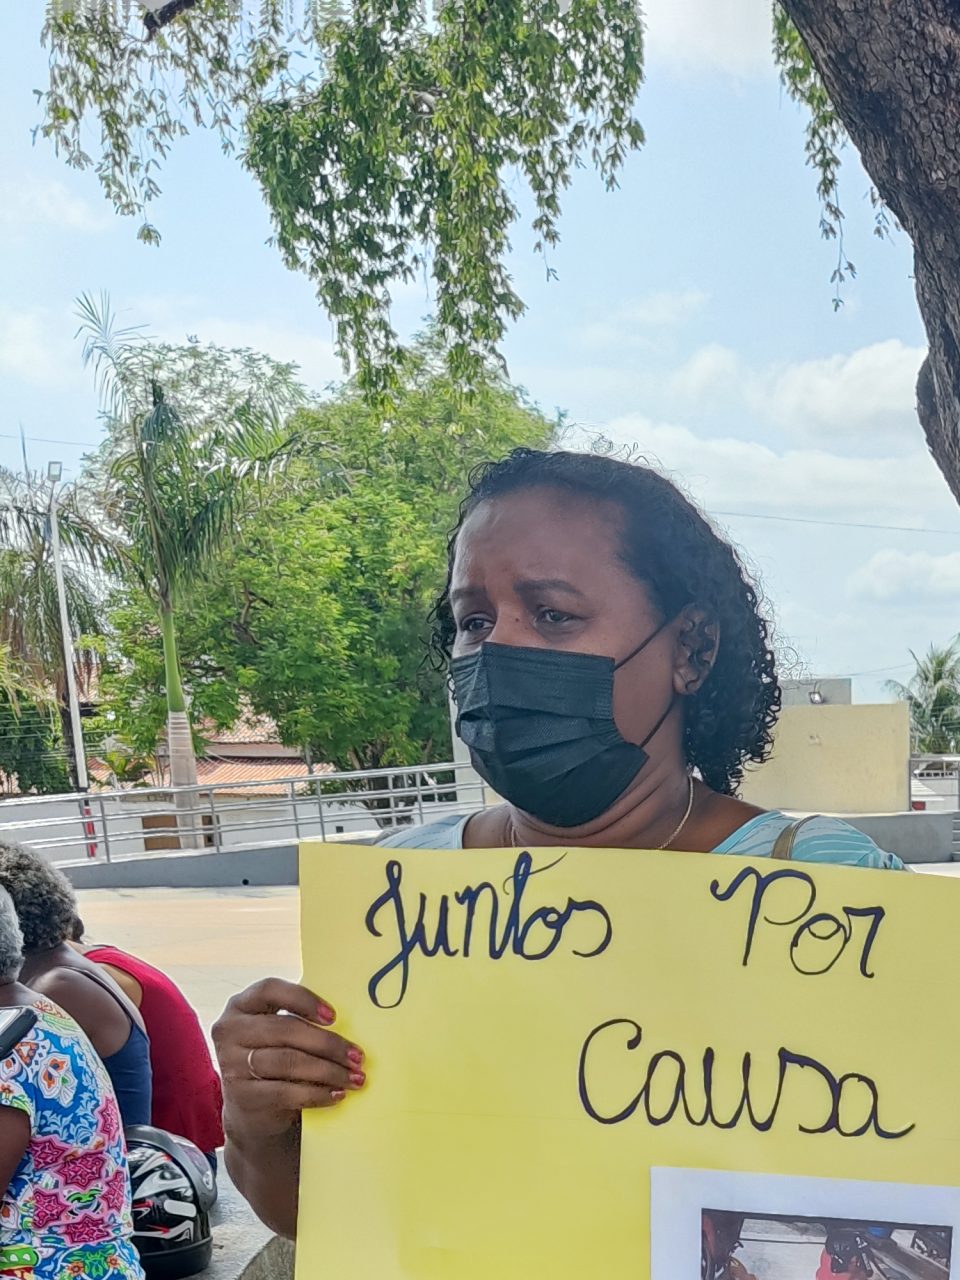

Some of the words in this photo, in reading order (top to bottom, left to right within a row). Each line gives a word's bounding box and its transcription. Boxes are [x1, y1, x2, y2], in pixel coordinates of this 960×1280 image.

[365, 850, 613, 1009] Juntos
[710, 866, 886, 979] Por
[578, 1018, 916, 1140] Causa
